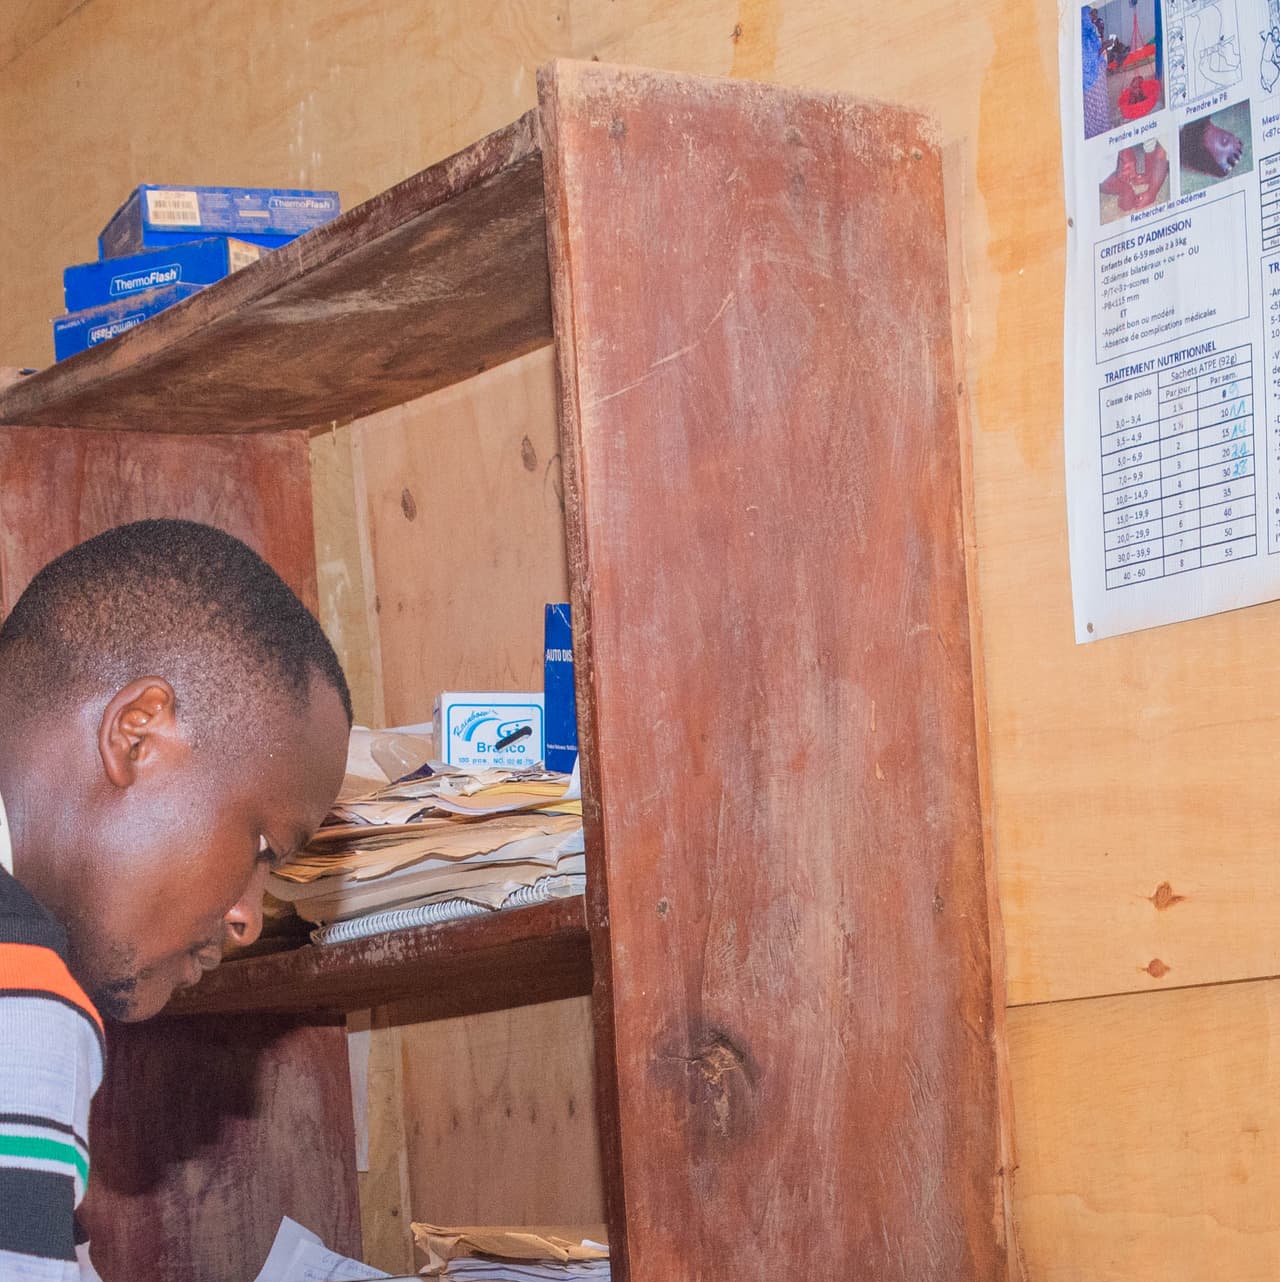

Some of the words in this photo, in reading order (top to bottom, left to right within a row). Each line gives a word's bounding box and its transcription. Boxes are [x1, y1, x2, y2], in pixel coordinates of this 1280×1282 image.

[274, 199, 331, 210] ThermoFlash
[1100, 237, 1135, 258] CRITERES
[115, 271, 177, 291] ThermoFlash
[1104, 359, 1154, 383] TRAITEMENT
[1157, 340, 1216, 367] NUTRITIONNEL
[546, 649, 562, 661] AUTO
